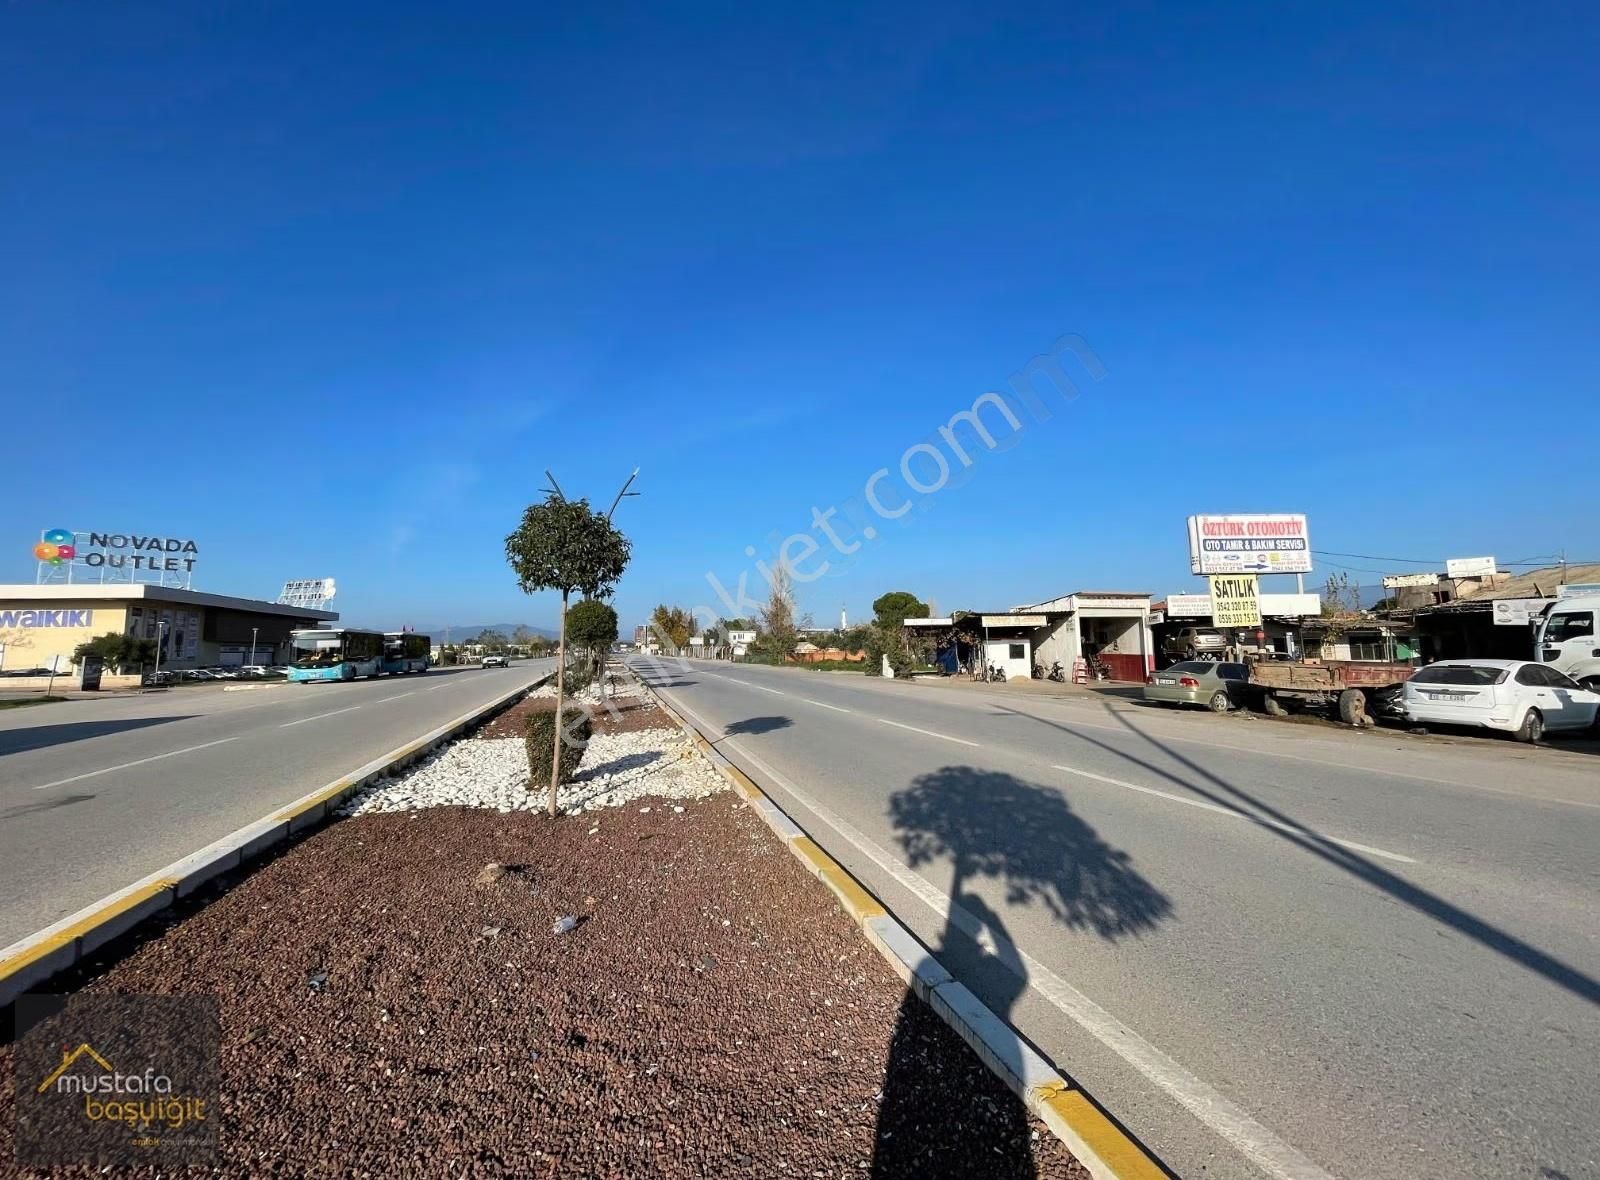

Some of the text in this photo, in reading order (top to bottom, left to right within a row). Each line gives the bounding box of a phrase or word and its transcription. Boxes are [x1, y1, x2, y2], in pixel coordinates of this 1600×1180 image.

[1203, 516, 1303, 536] ÖZTÜRK OTOMOTİV
[89, 532, 198, 554] NOVADA
[1206, 540, 1220, 551] OTO
[1245, 540, 1250, 550] &
[1251, 539, 1275, 550] BAKIM
[85, 552, 197, 572] OUTLET
[1214, 579, 1256, 599] SATILIK
[1216, 601, 1230, 611] 0542
[1231, 601, 1242, 611] 320
